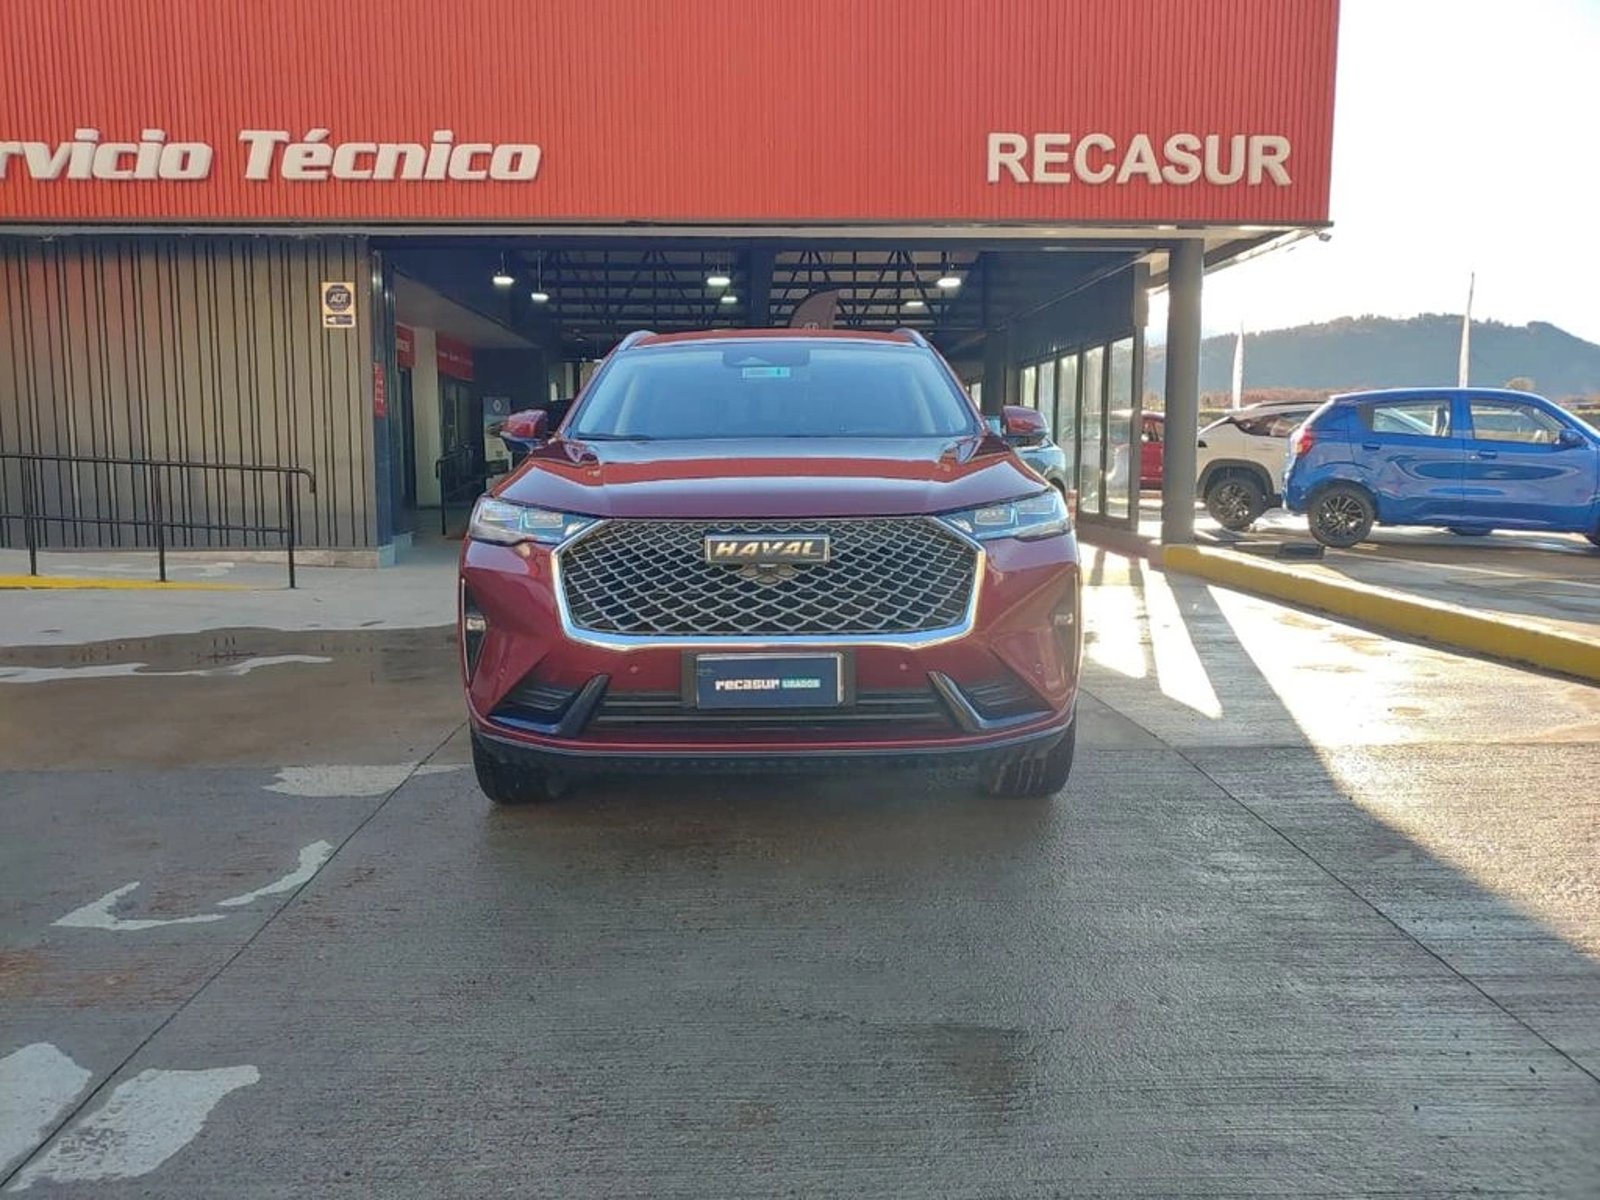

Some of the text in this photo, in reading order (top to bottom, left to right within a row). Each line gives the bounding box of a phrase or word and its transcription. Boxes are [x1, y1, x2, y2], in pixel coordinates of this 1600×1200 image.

[239, 128, 542, 182] Técnico
[986, 132, 1293, 187] RECASUR
[714, 541, 821, 557] HAVAL
